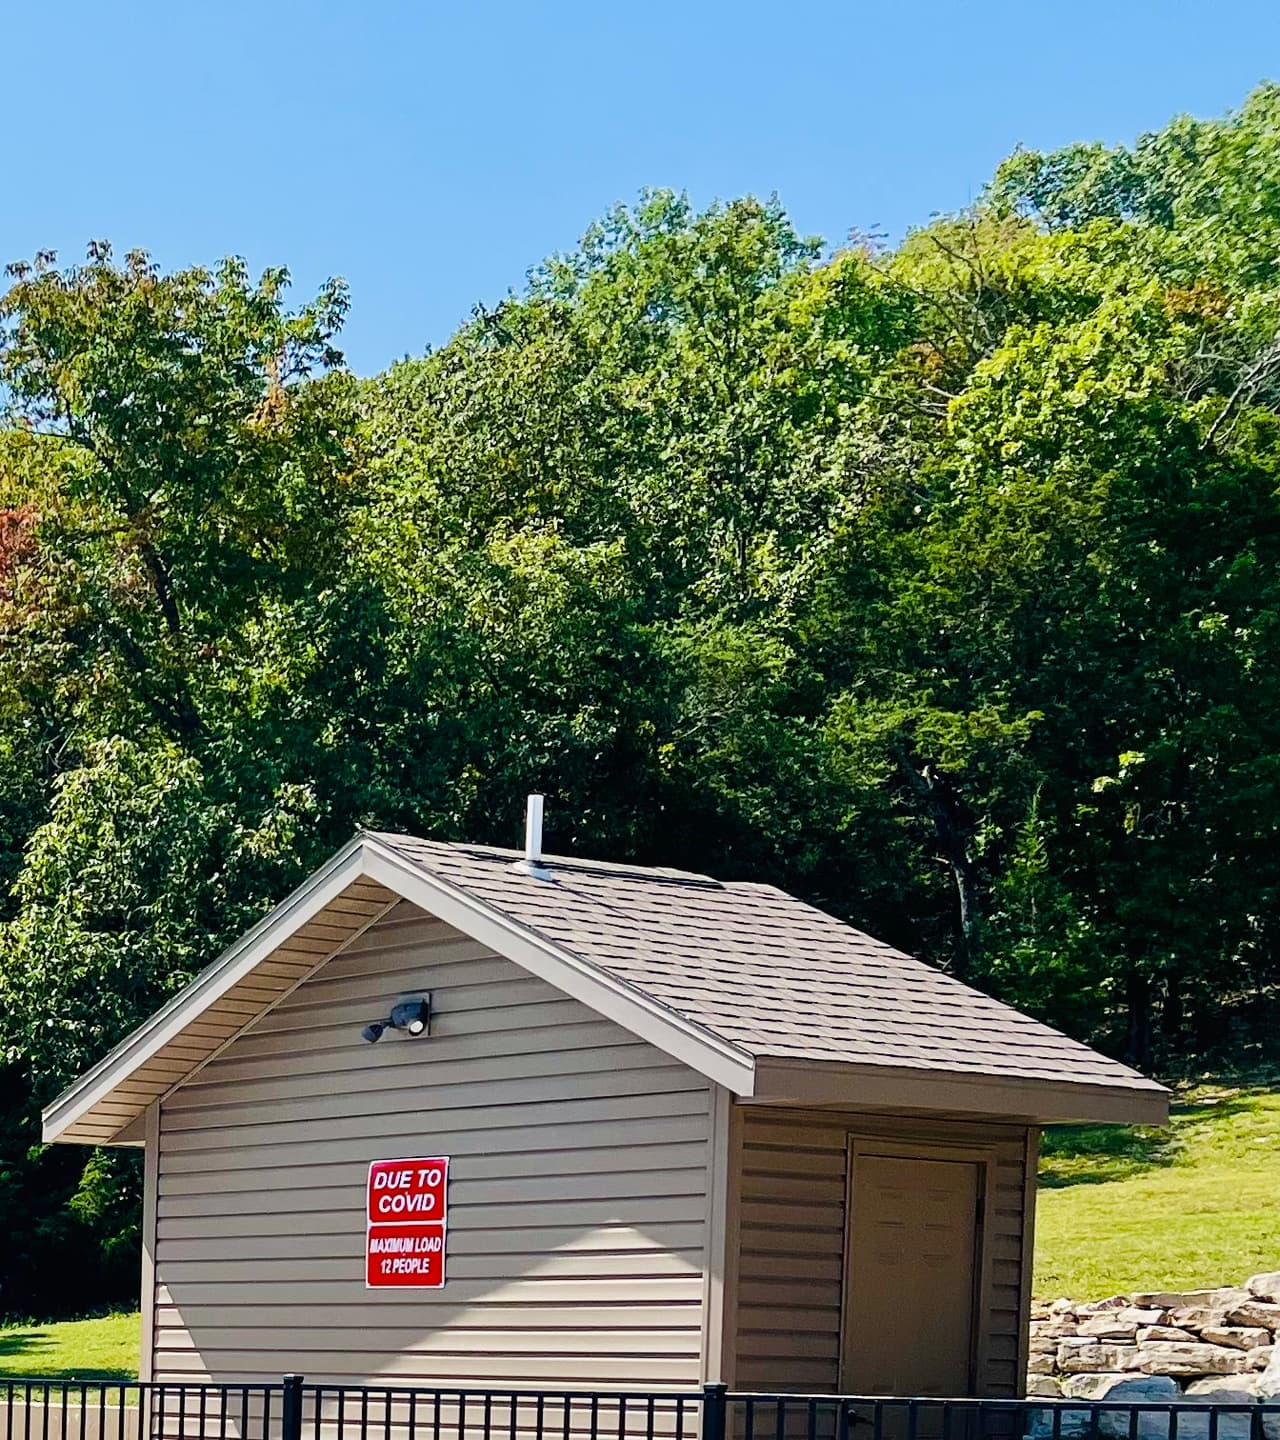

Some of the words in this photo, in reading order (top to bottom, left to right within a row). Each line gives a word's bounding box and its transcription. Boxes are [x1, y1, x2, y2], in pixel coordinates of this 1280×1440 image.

[374, 1170, 413, 1189] DUE
[418, 1169, 441, 1187] TO
[379, 1194, 435, 1213] COVID
[370, 1237, 414, 1253] MAXIMUM
[415, 1236, 441, 1252] LOAD
[381, 1259, 391, 1274] 12
[392, 1258, 430, 1273] PEOPLE
